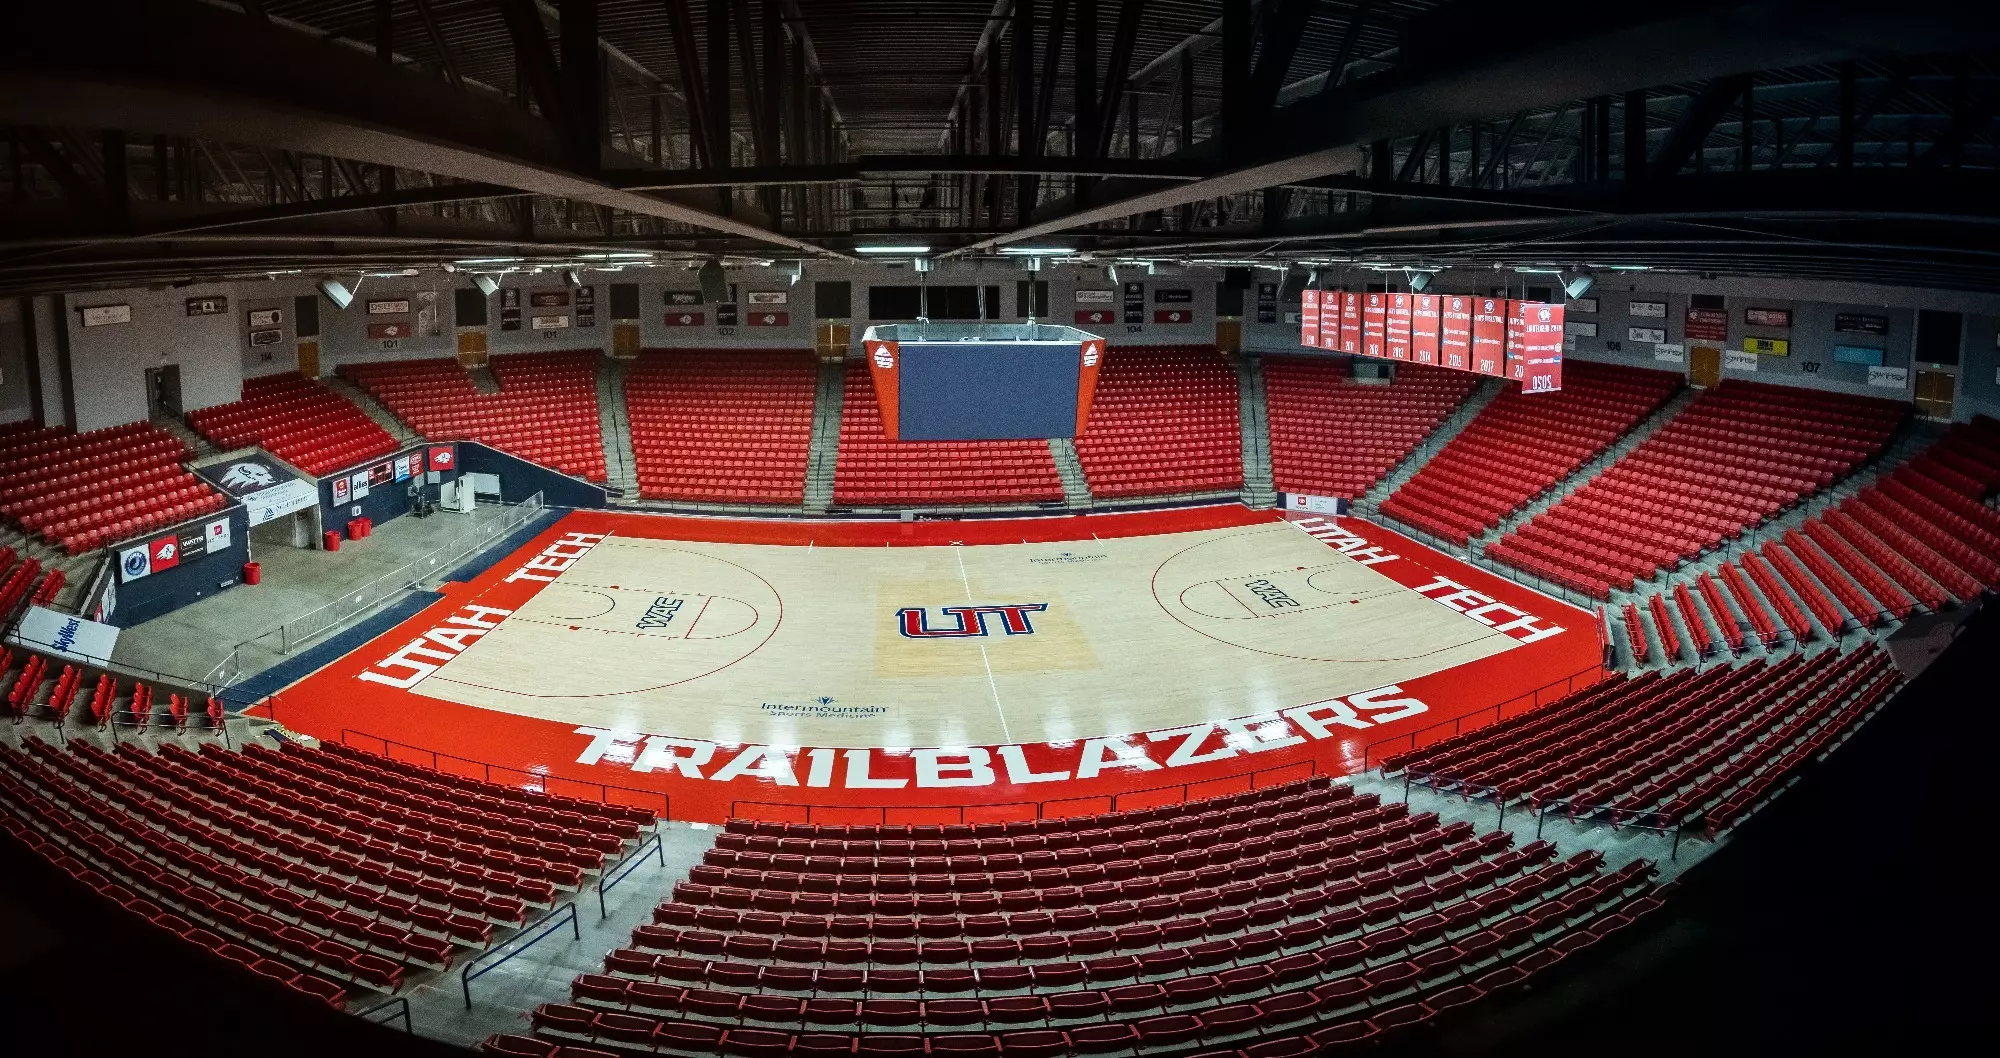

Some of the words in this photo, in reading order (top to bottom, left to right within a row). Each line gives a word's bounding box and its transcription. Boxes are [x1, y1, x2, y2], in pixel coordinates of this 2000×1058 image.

[543, 331, 557, 339] 101
[718, 327, 736, 336] 102
[1126, 325, 1142, 334] 104
[383, 340, 398, 348] 101
[1606, 341, 1622, 352] 106
[1392, 347, 1404, 359] 2013
[1448, 353, 1462, 368] 2015
[1480, 358, 1495, 373] 2017
[1802, 361, 1821, 373] 107
[1514, 364, 1525, 378] 20
[1291, 517, 1400, 565] UTAH
[504, 531, 606, 584] TECH
[1410, 576, 1568, 644] TECH
[894, 602, 1049, 639] UT
[52, 617, 81, 652] SkyWest
[357, 604, 514, 689] UTAH
[761, 702, 887, 713] Intermountain
[816, 711, 876, 719] Medicine
[572, 685, 1430, 789] TRAILBLAZERS
